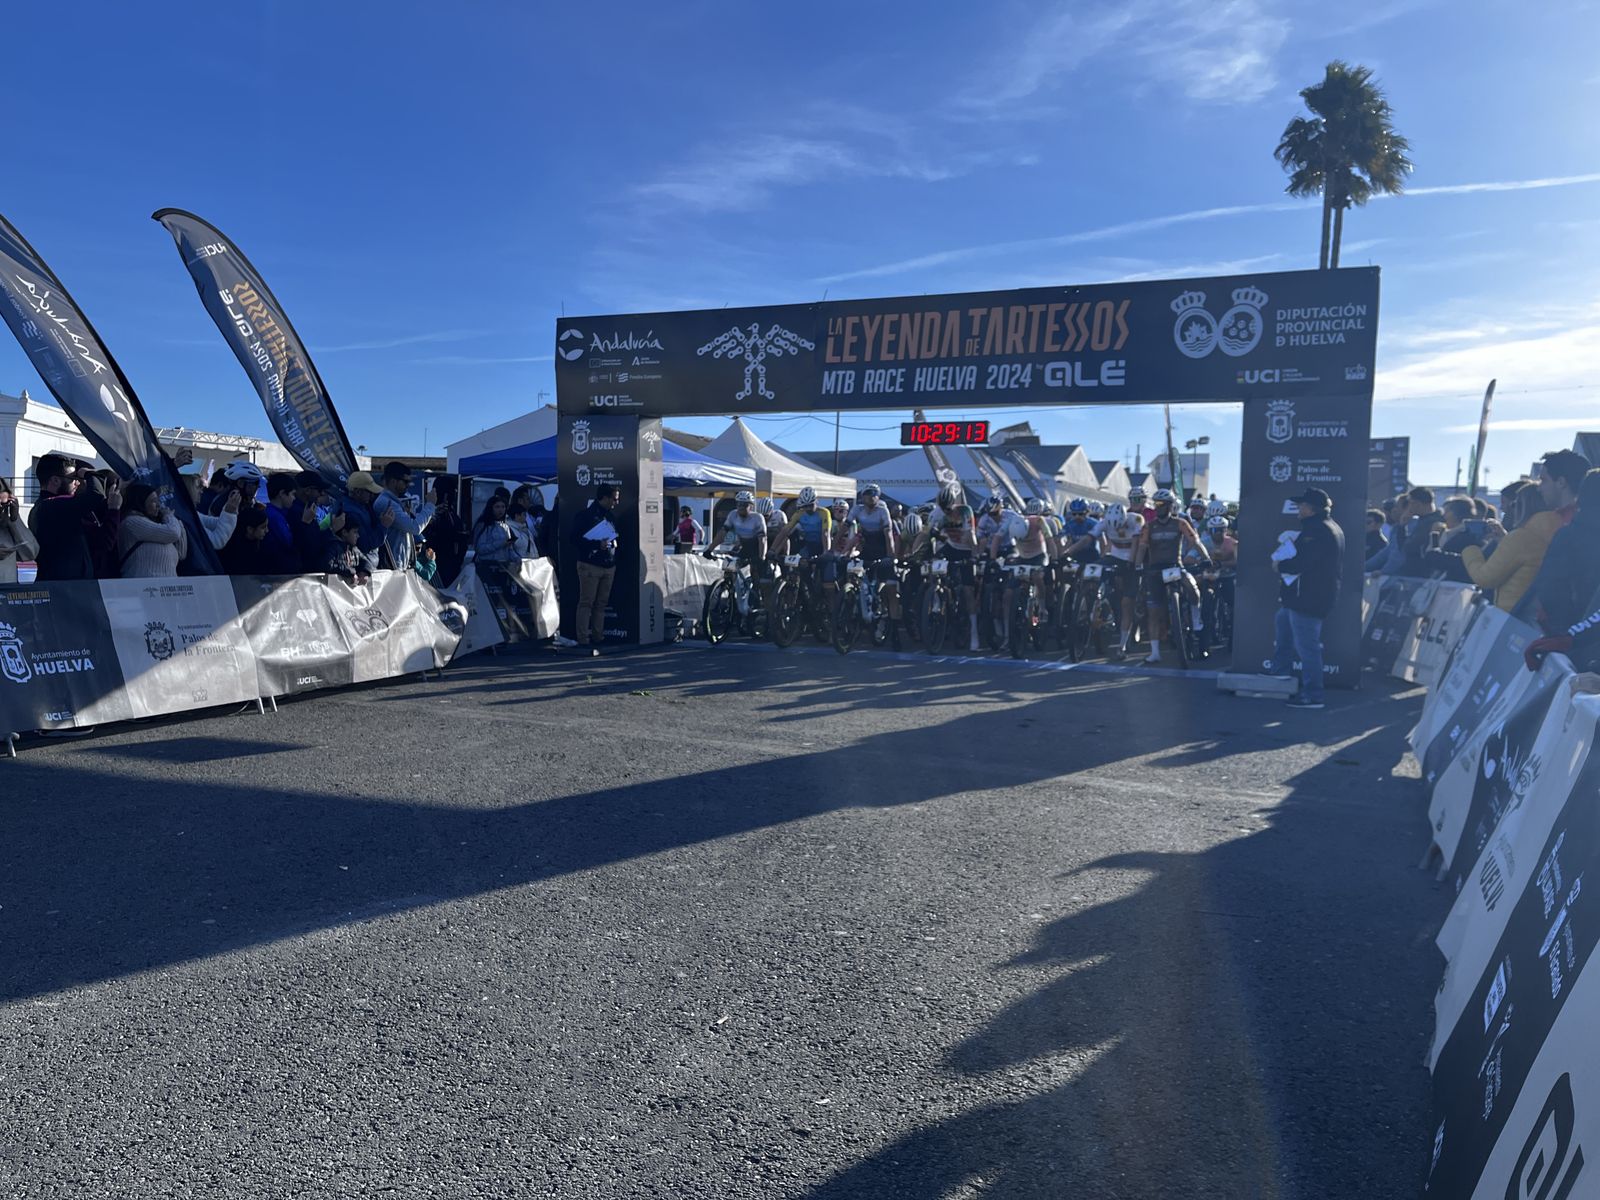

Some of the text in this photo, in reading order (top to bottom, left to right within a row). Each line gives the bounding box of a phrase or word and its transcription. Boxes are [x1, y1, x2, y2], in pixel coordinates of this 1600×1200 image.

[1276, 303, 1367, 321] DIPUTACIÓN
[968, 300, 1131, 356] TARTESSOS
[1276, 319, 1365, 334] PROVINCIAL
[589, 330, 664, 353] Andalucía
[825, 309, 961, 363] LEYENDA
[1290, 332, 1346, 347] HUELVA
[965, 338, 979, 357] DE
[822, 370, 854, 395] MTB
[862, 368, 906, 393] RACE
[913, 366, 977, 392] HUELVA
[986, 363, 1032, 390] 2024
[1244, 369, 1280, 384] UCI
[594, 395, 618, 407] UCI
[911, 423, 986, 443] 10:29:13
[1297, 427, 1348, 437] HUELVA
[592, 442, 624, 450] HUELVA
[181, 632, 218, 643] Palos de
[31, 650, 80, 661] Ayuntamiento
[184, 645, 236, 656] la Frontera
[33, 658, 95, 675] HUELVA
[300, 677, 310, 685] UCI
[45, 712, 62, 721] UCI
